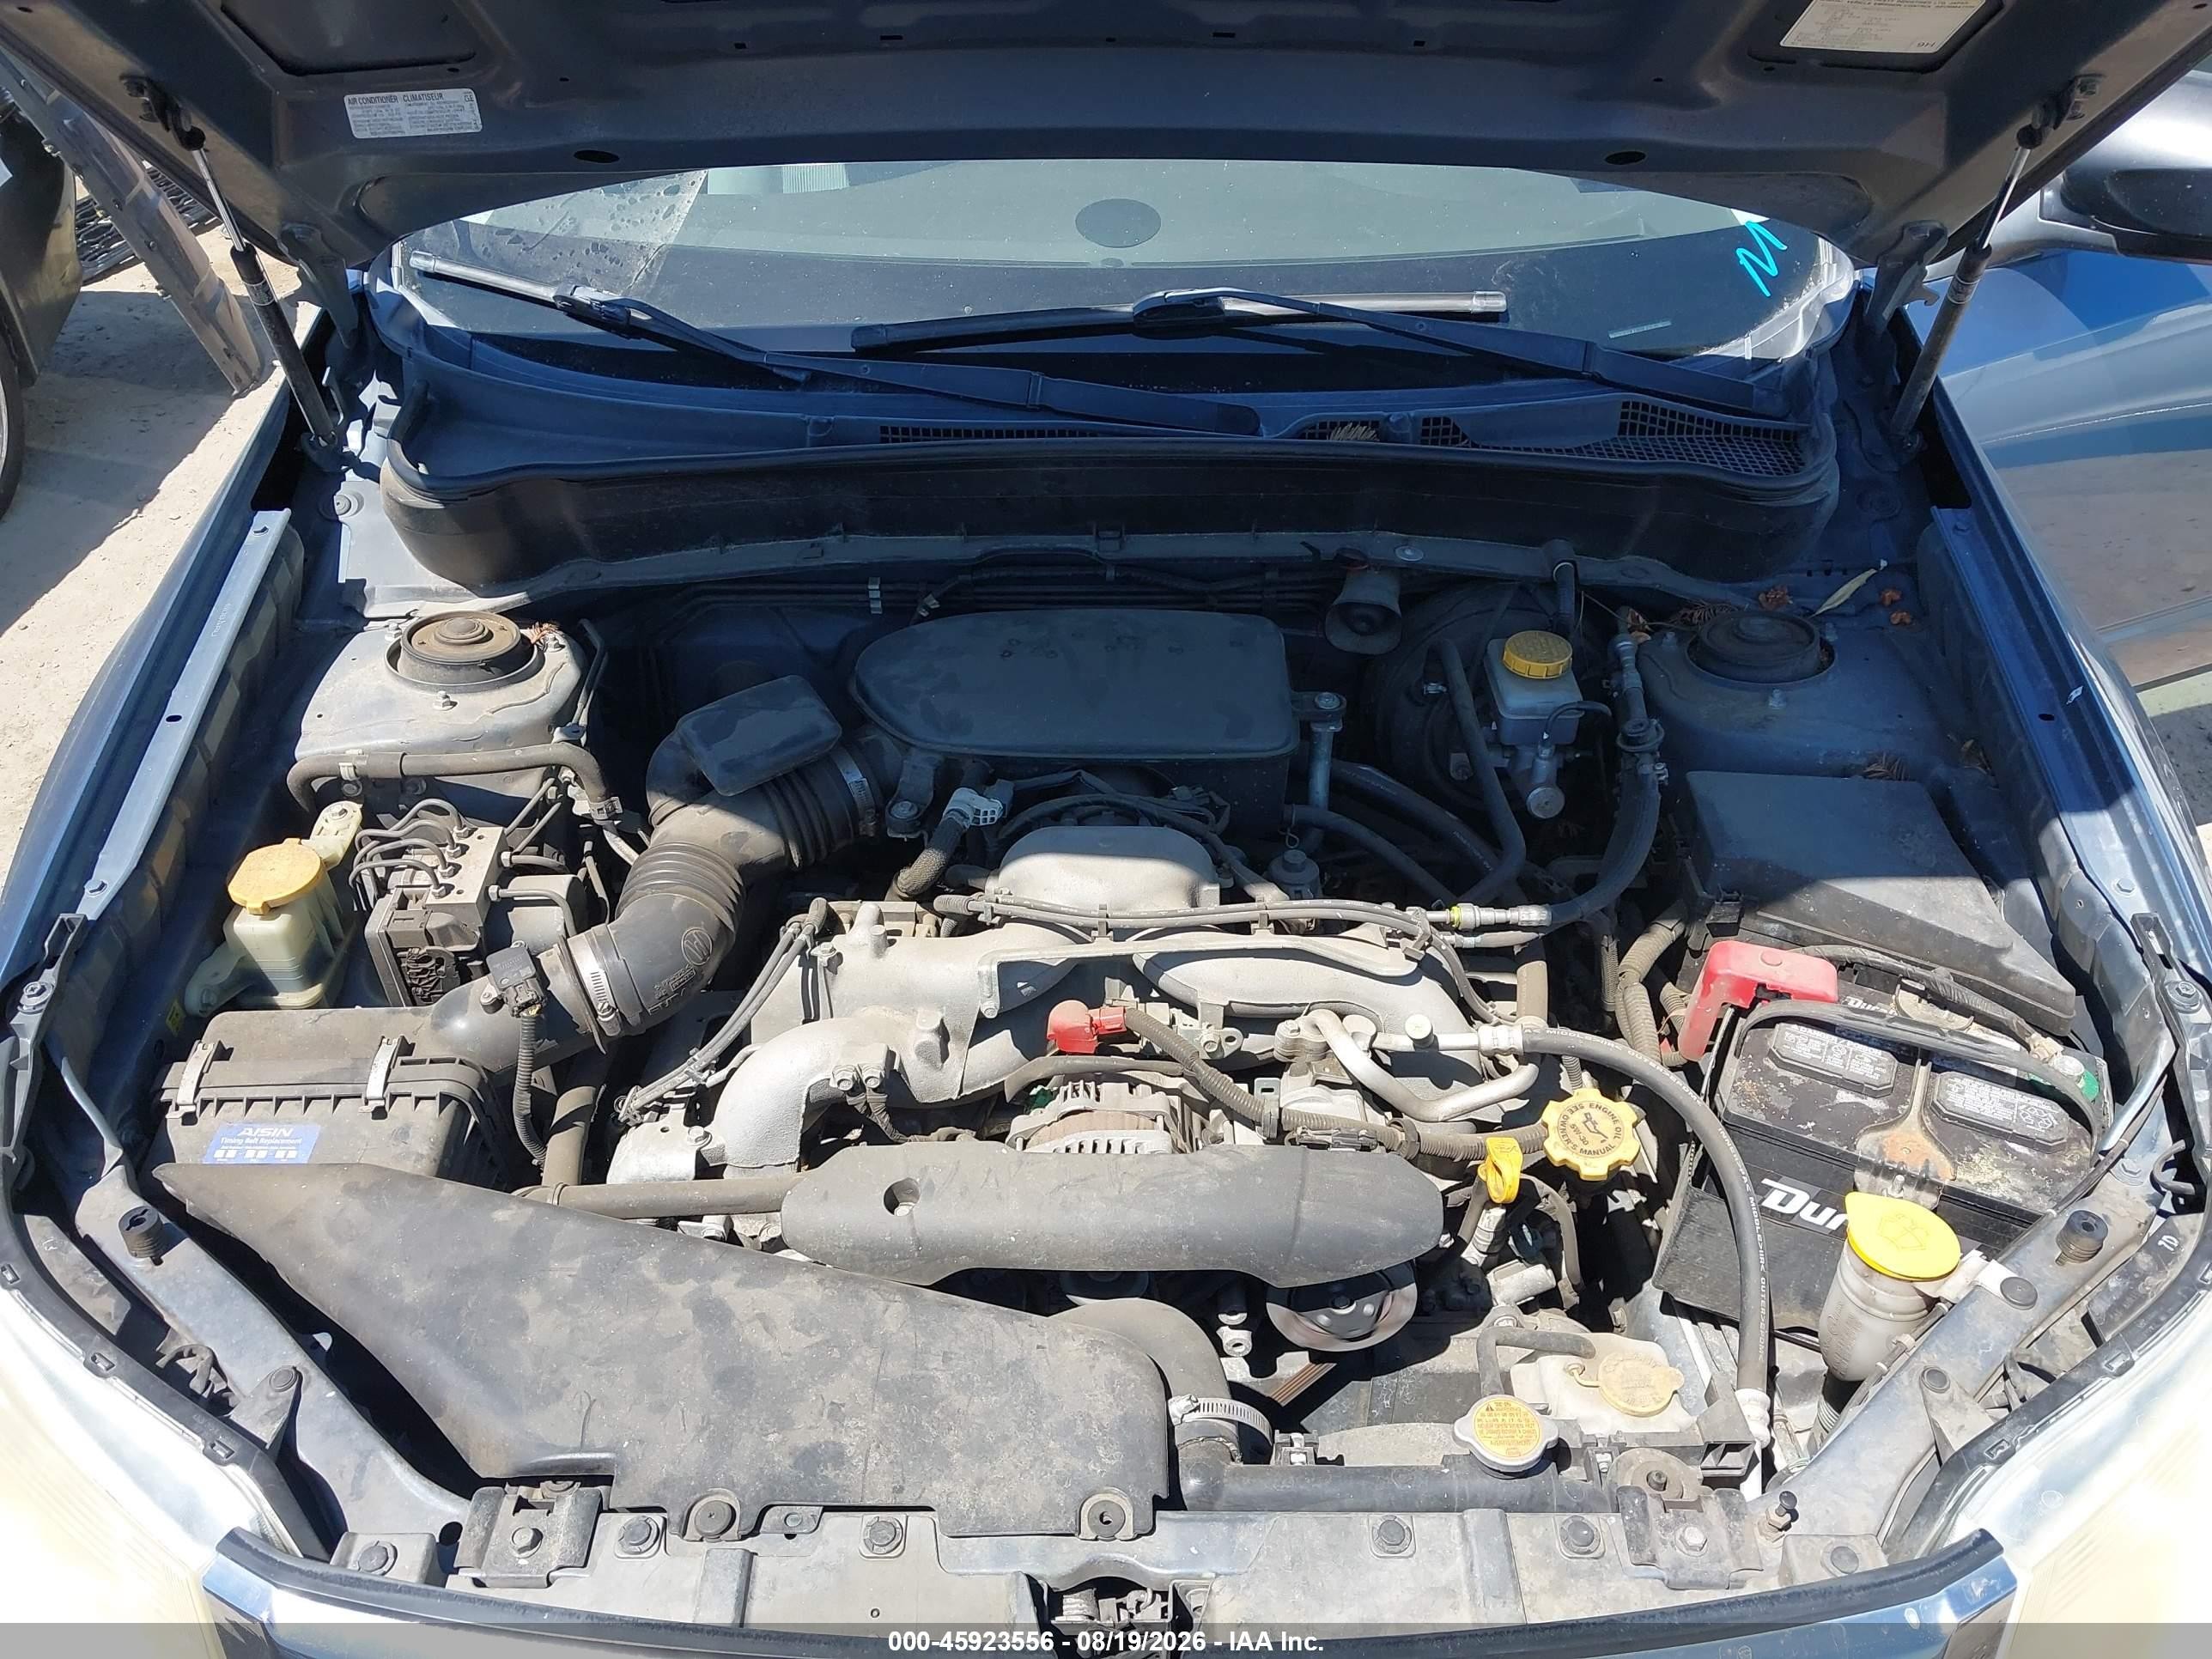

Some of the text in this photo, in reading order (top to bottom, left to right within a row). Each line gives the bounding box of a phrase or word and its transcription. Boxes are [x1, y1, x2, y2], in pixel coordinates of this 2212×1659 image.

[348, 93, 444, 106] AIR CONDITIONER CLIMATISEUR
[239, 1127, 294, 1138] AISIN
[1559, 1103, 1616, 1156] SEE OWNER'S MANUAL
[1589, 1102, 1623, 1140] ENGINE OIL
[220, 1137, 244, 1146] Timing
[259, 1137, 303, 1146] Replacement
[1570, 1123, 1589, 1146] 5W-30
[1761, 1177, 1849, 1231] Dur
